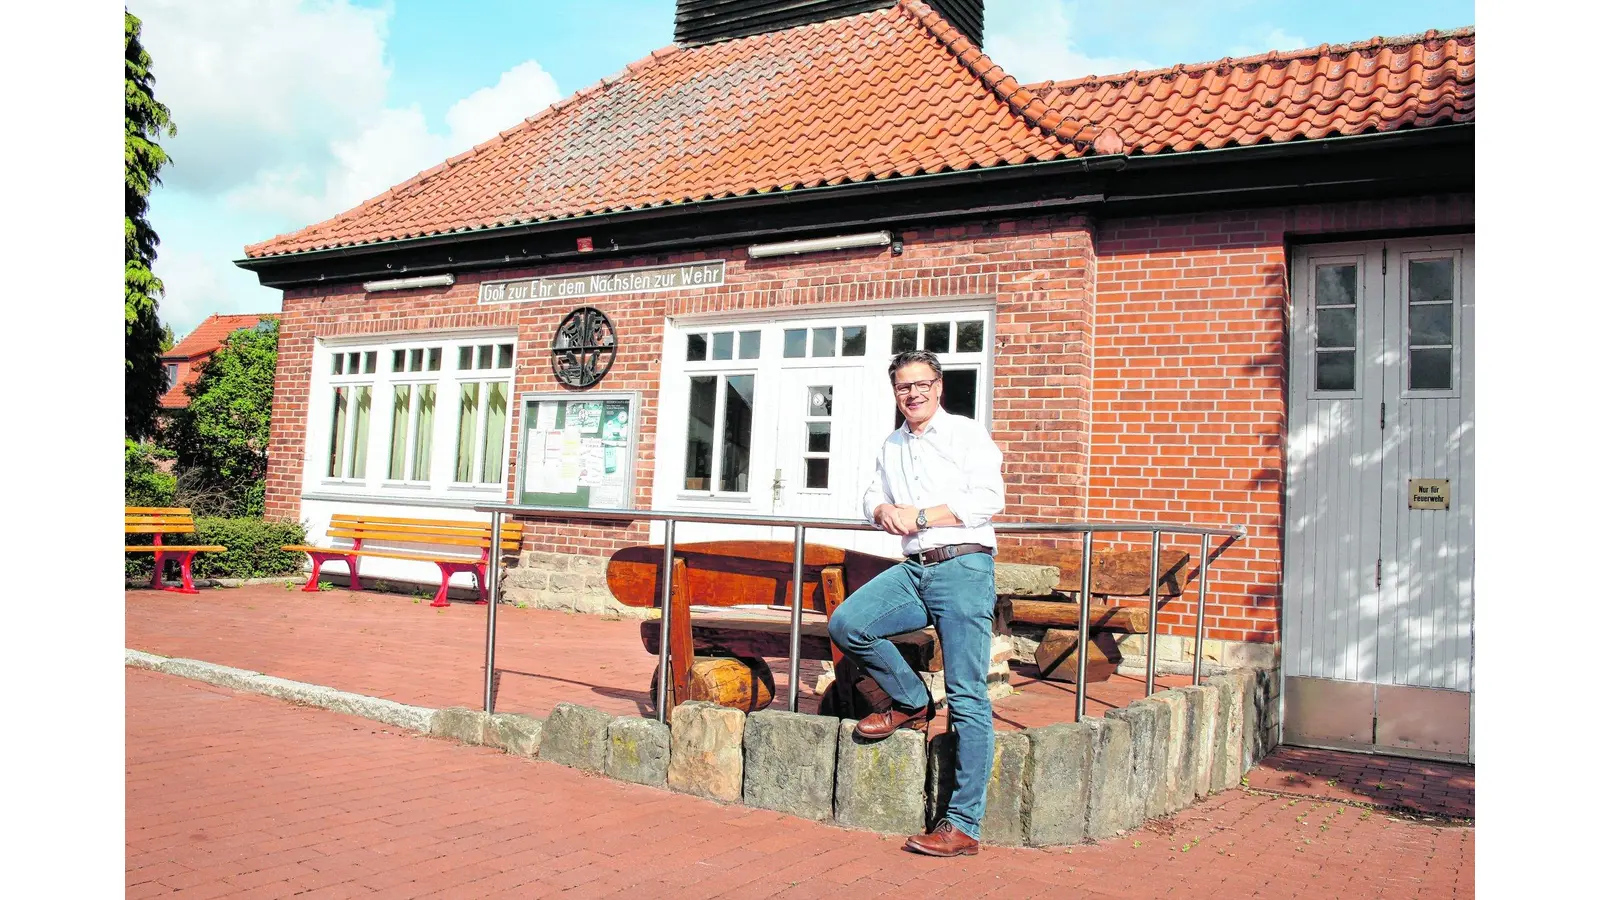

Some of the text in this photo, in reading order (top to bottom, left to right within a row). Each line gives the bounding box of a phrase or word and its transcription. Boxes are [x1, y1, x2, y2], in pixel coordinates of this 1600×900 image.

[484, 284, 506, 301] Gott
[508, 286, 529, 300] zur
[558, 279, 585, 296] dem
[590, 273, 650, 293] Nächsten
[654, 272, 676, 289] zur
[681, 265, 719, 285] Wehr
[1413, 494, 1444, 502] Feuerwehr
